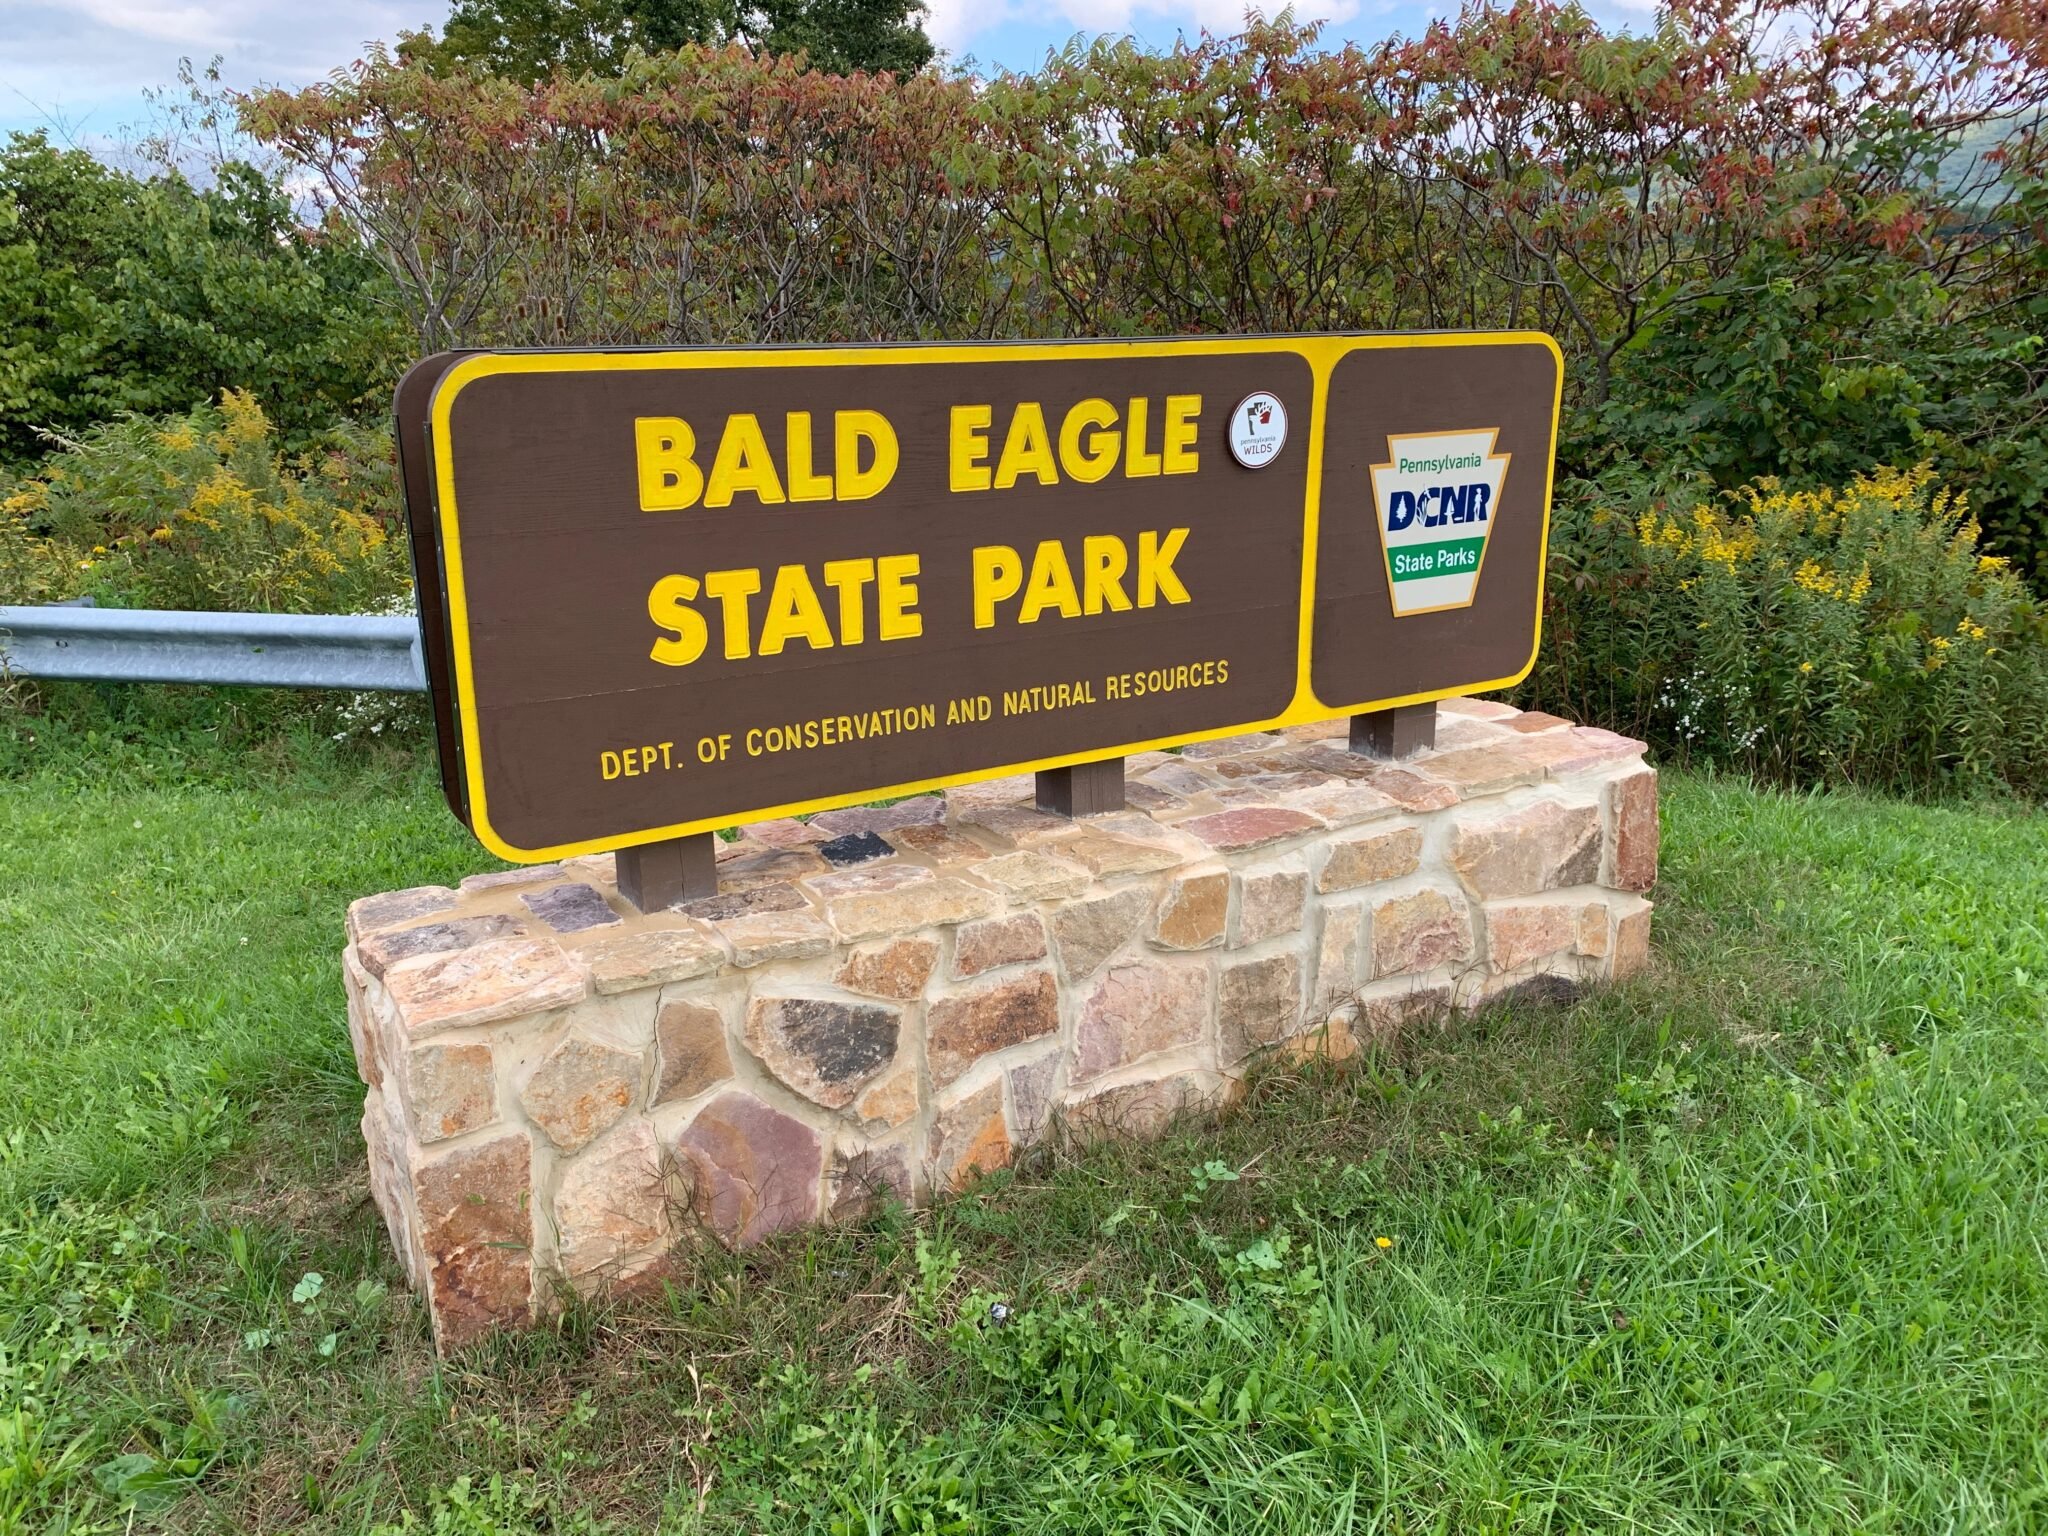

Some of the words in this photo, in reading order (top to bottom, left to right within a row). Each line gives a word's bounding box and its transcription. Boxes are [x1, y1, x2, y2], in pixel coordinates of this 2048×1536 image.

[634, 409, 900, 512] BALD
[949, 394, 1203, 493] EAGLE
[1243, 443, 1273, 455] WILDS
[1399, 452, 1482, 475] Pennsylvania
[1387, 482, 1491, 532] DCNR
[1394, 553, 1434, 574] State
[1437, 547, 1476, 569] Parks
[647, 553, 924, 667] STATE
[972, 527, 1192, 630] PARK
[600, 741, 684, 781] DEPT.
[697, 733, 732, 764] OF
[745, 703, 936, 758] CONSERVATION
[946, 695, 992, 725] AND
[1003, 680, 1097, 717] NATURAL
[1106, 659, 1229, 700] RESOURCES
